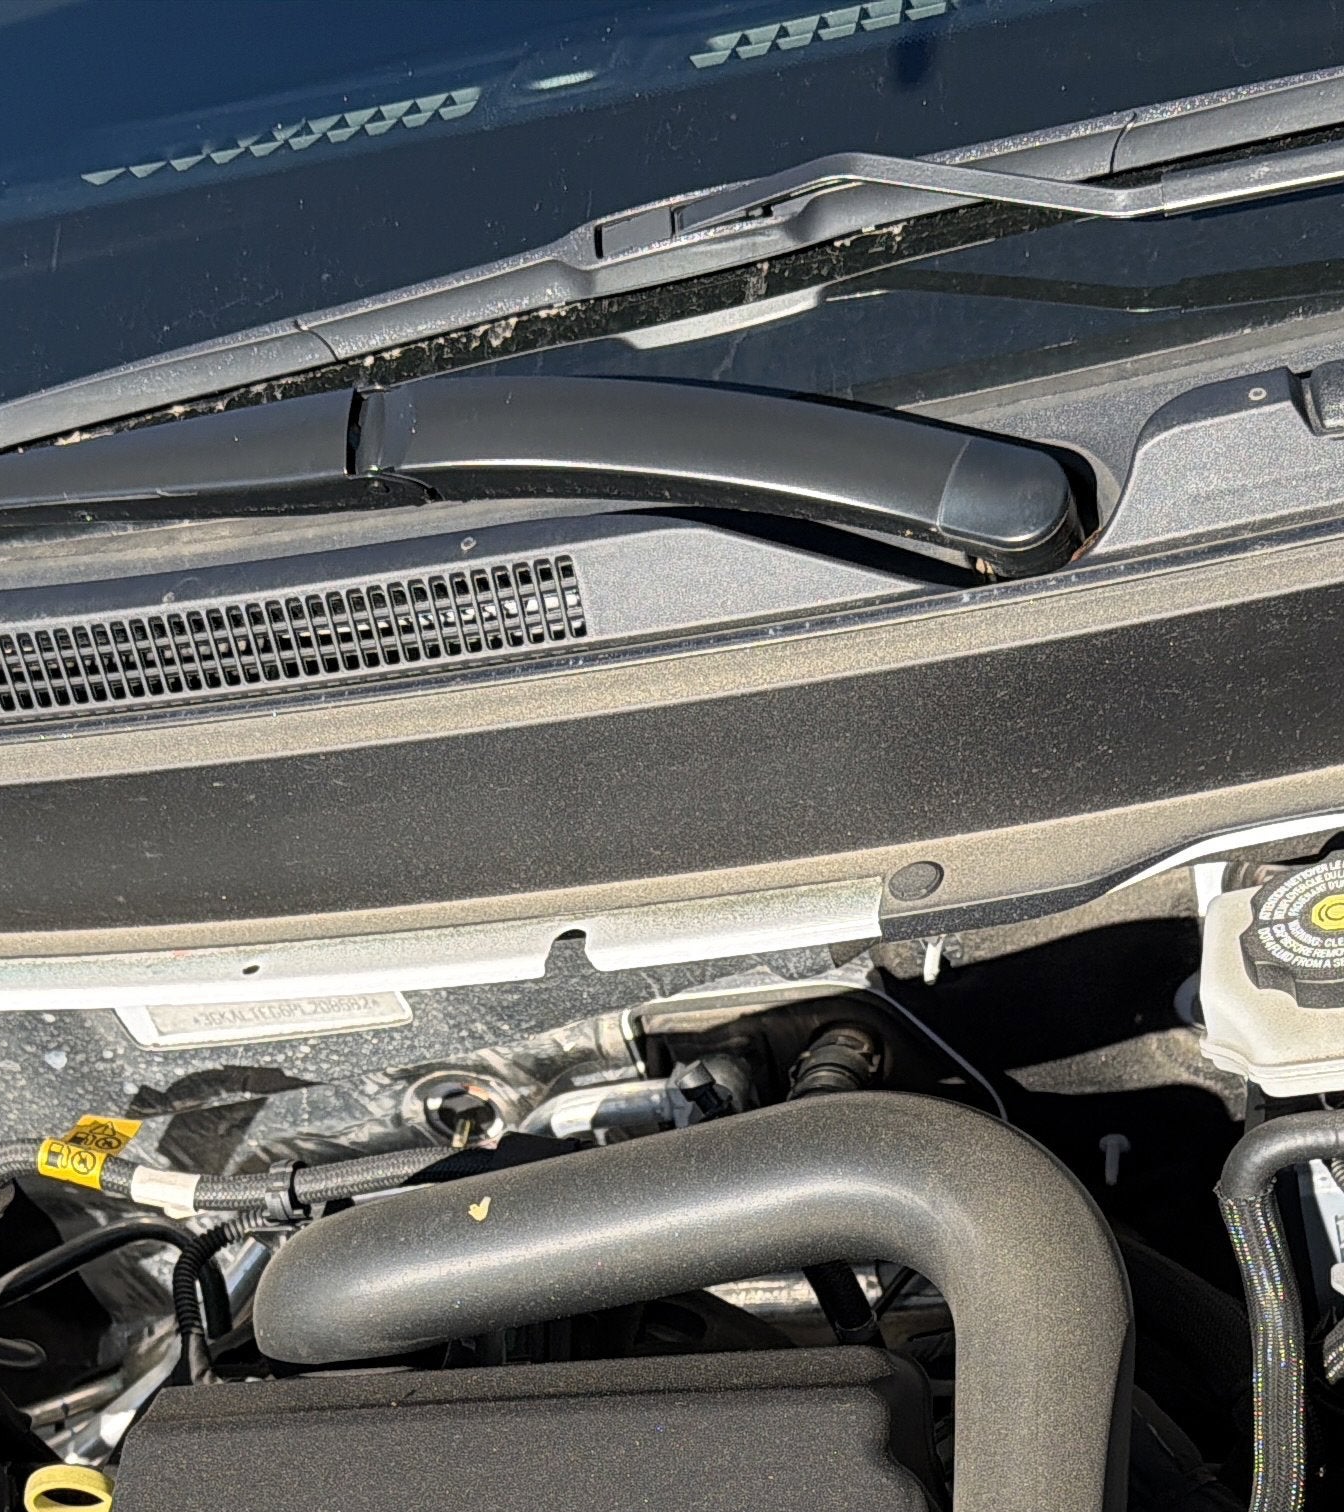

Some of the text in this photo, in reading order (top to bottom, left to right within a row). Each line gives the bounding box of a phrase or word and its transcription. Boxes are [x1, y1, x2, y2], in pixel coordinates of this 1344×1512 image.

[1328, 859, 1341, 870] LE
[1322, 870, 1336, 881] DU
[1278, 934, 1314, 957] BEFORE
[1266, 943, 1296, 963] FLUID
[1289, 954, 1323, 969] FROM
[1322, 959, 1332, 968] A
